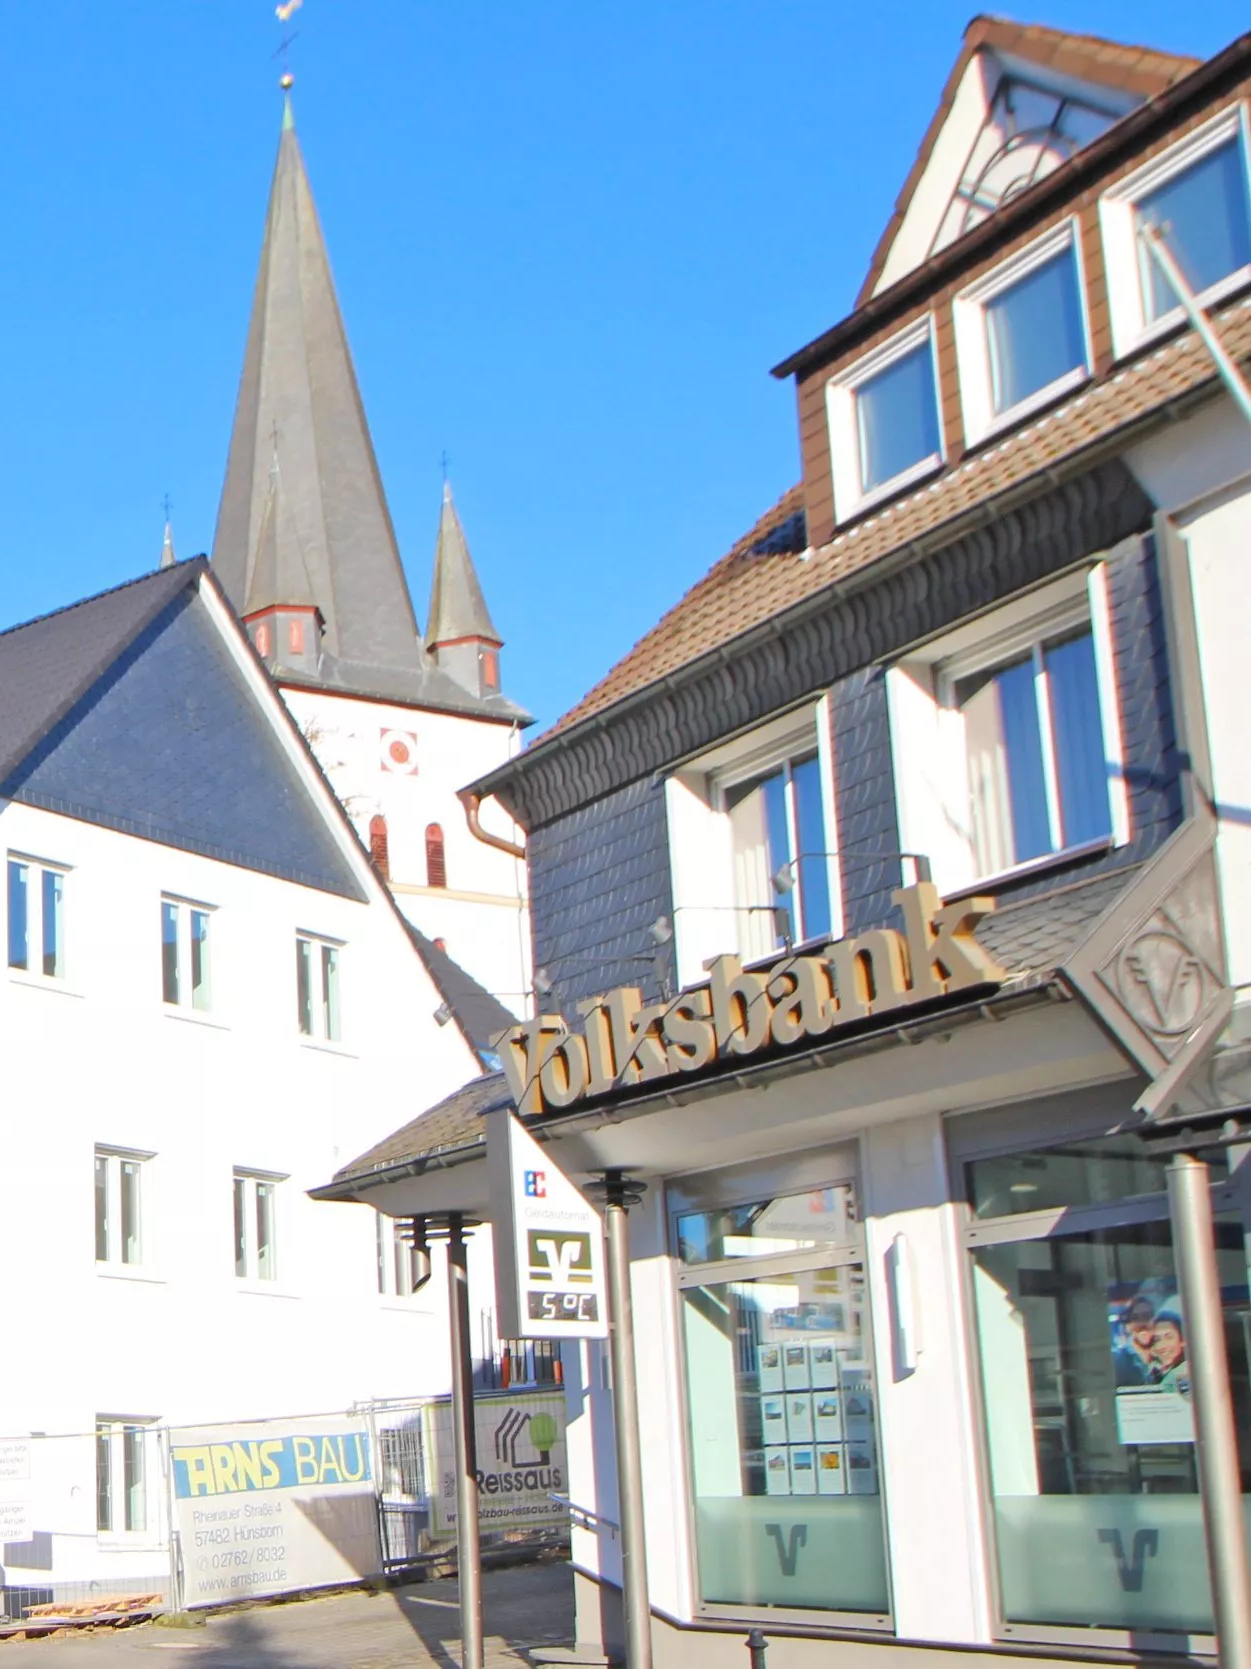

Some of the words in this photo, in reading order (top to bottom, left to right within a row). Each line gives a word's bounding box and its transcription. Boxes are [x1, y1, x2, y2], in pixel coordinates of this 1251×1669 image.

[490, 882, 1006, 1117] Volksbank
[525, 1207, 589, 1221] Geldautomat
[173, 1440, 283, 1496] ARNS
[292, 1434, 364, 1485] BAU
[475, 1468, 562, 1495] Reissaus
[195, 1528, 230, 1547] 57482
[234, 1523, 283, 1542] Hünsborn
[198, 1569, 288, 1592] www.arnsbau.de
